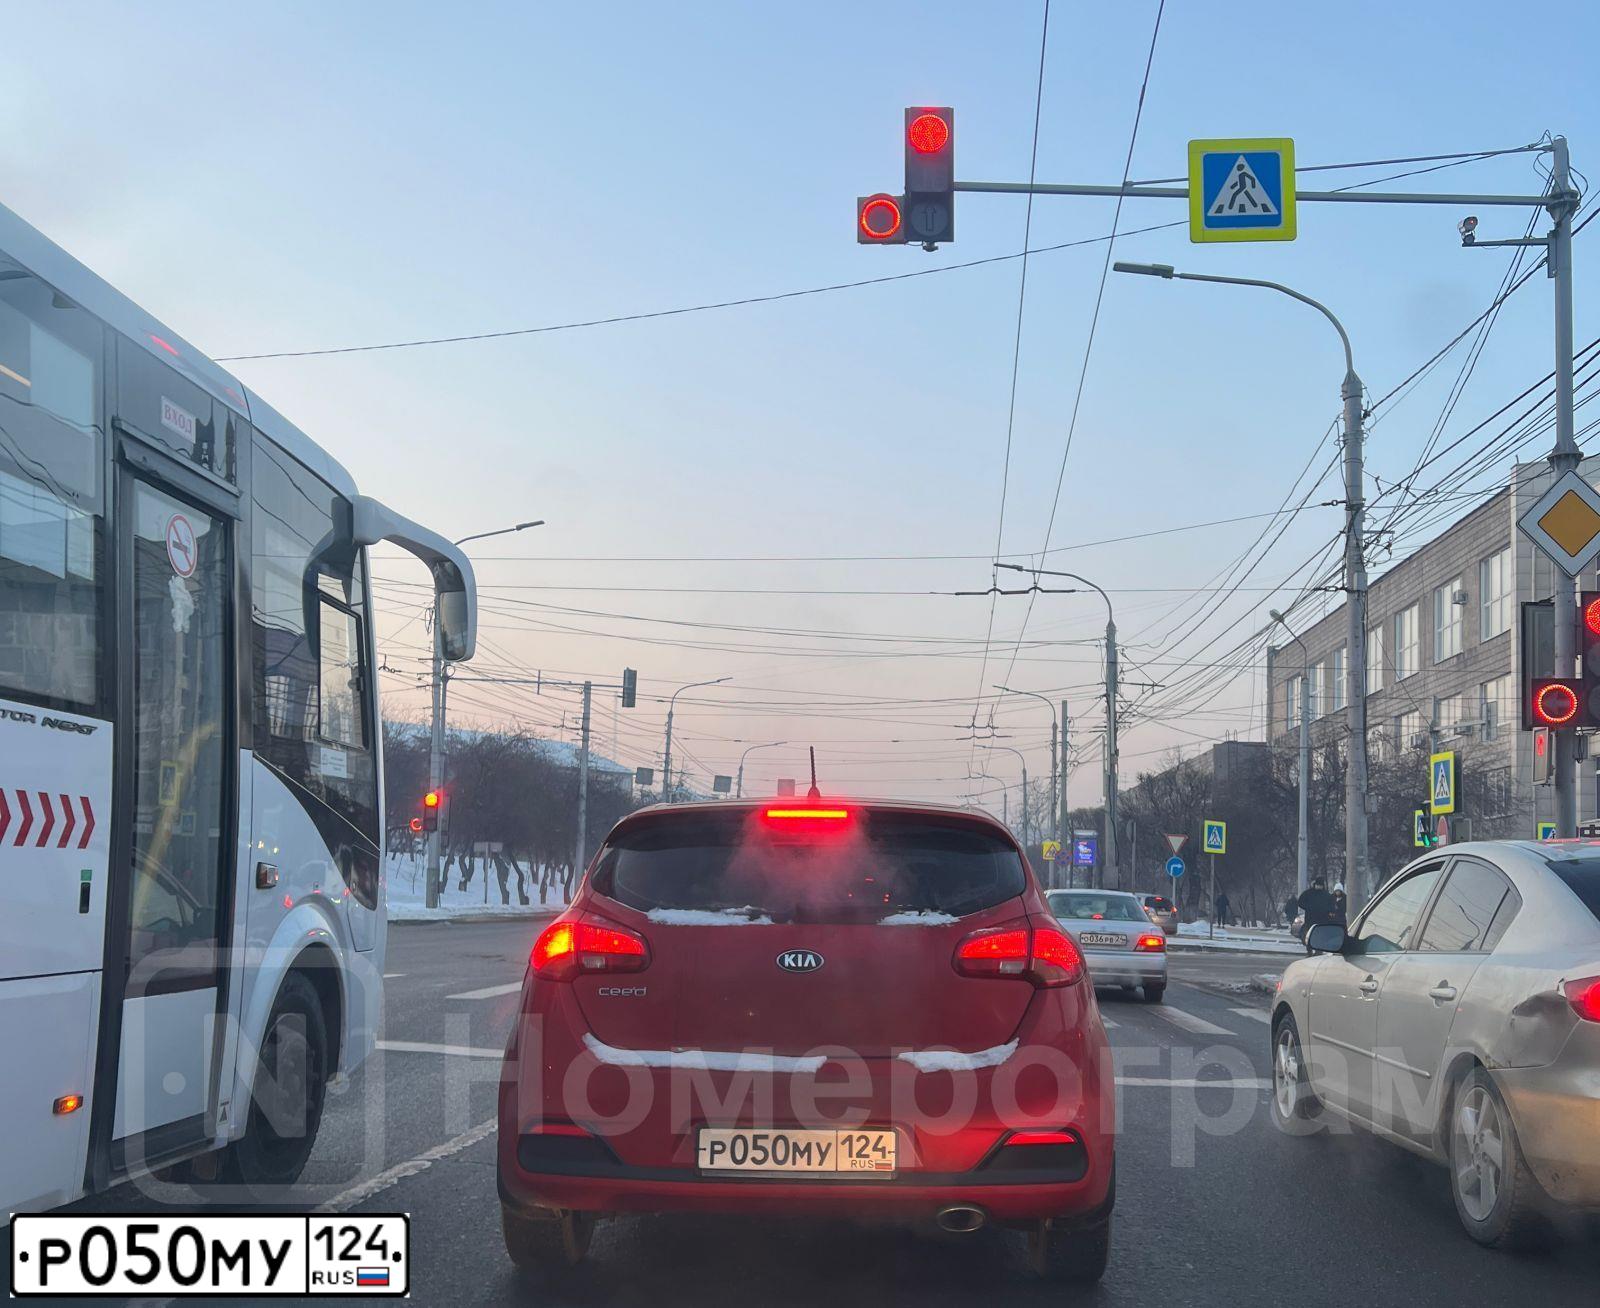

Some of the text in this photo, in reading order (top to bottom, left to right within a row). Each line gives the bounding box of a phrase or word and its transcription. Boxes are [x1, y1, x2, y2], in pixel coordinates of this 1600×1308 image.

[164, 404, 192, 434] ВХОД
[41, 716, 98, 735] NEXT
[784, 954, 816, 967] KIA
[709, 1134, 887, 1167] Р050МУ 124
[850, 1159, 874, 1169] RUS
